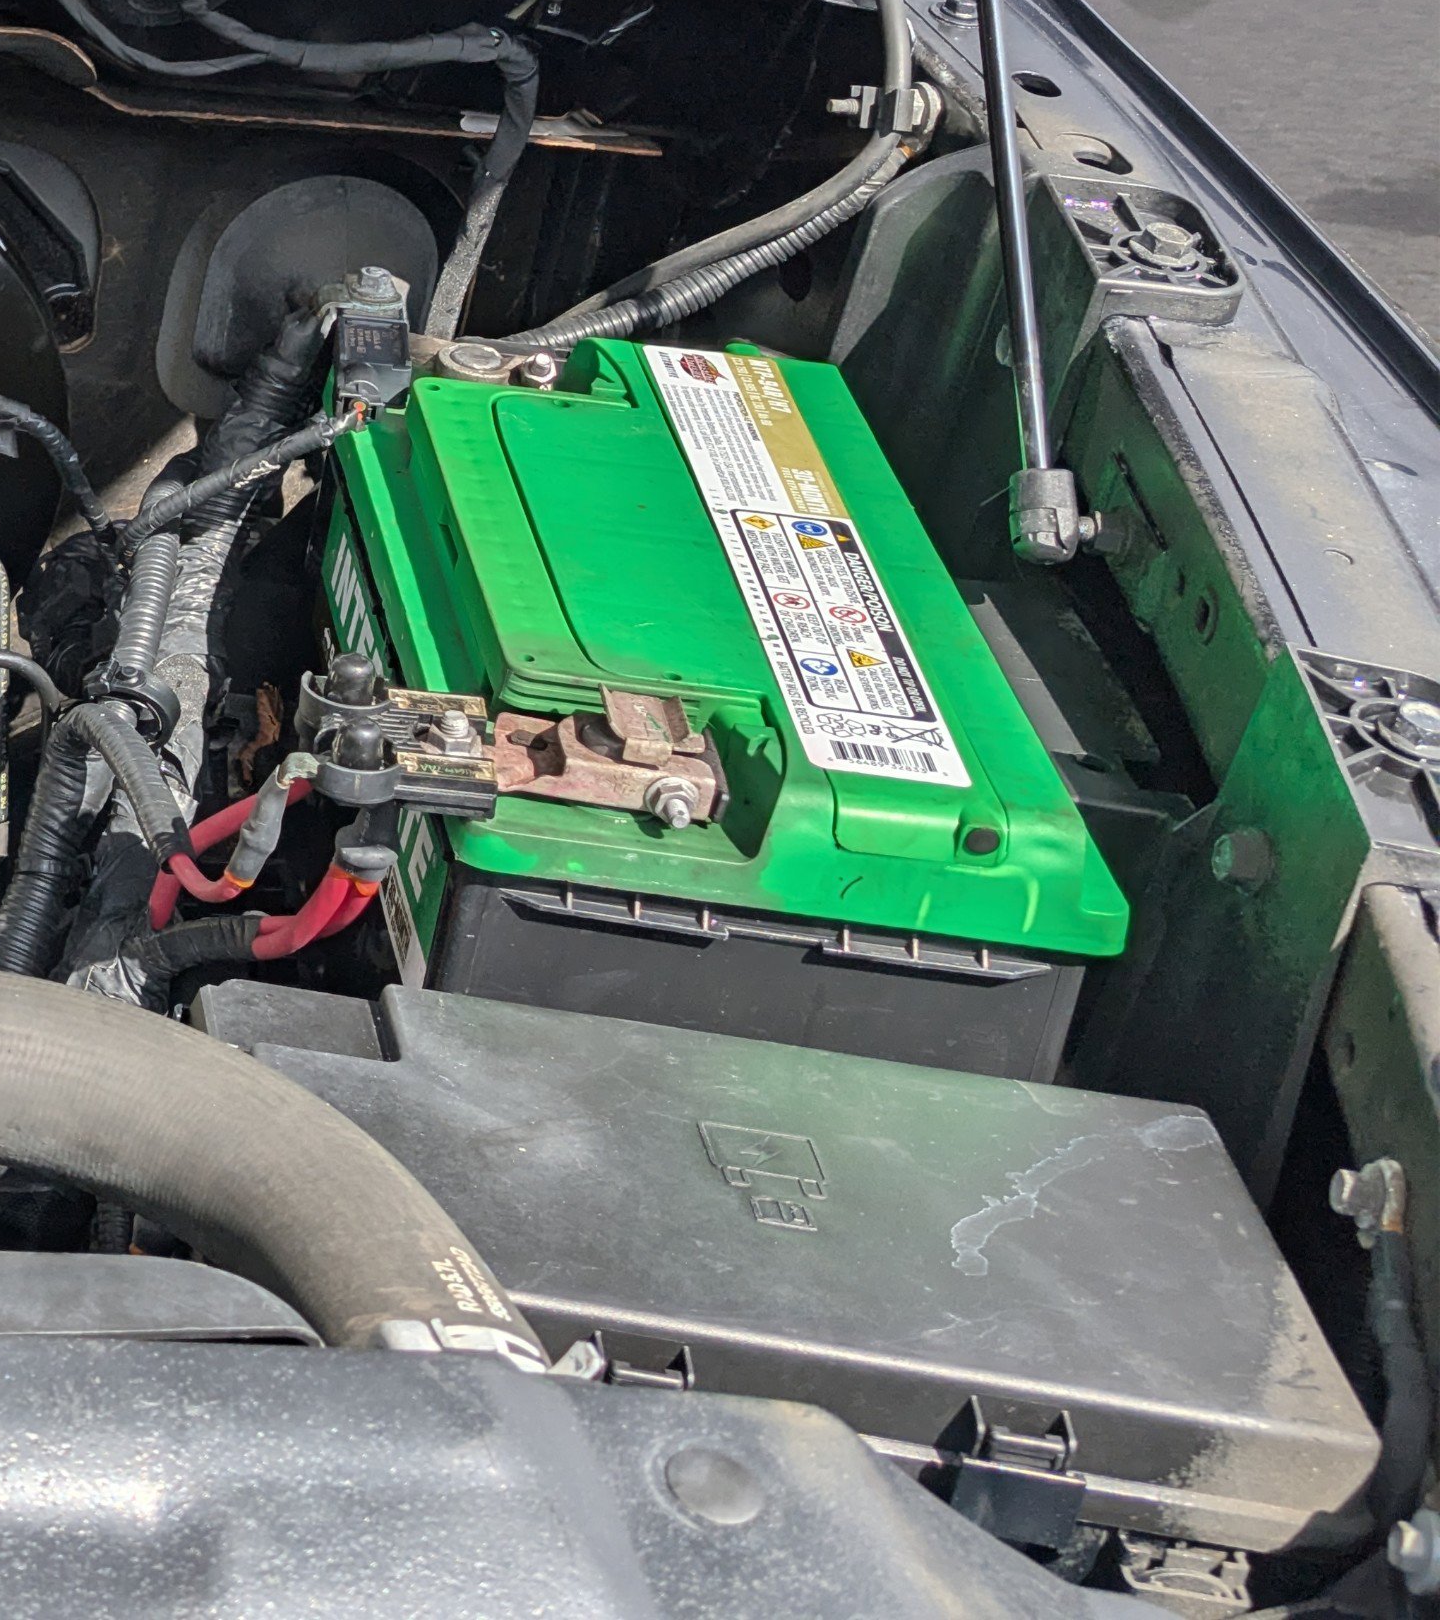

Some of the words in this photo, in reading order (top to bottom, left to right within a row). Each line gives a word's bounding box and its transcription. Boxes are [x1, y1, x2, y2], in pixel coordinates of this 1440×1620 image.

[746, 358, 792, 414] MTP-94R/H7
[789, 467, 831, 515] 30-MONTH
[843, 551, 894, 633] DANGER/POISON
[777, 609, 790, 617] OF
[791, 610, 805, 621] THE
[804, 612, 820, 627] KEEP
[795, 621, 812, 638] REACH
[810, 626, 825, 638] OUT
[860, 624, 874, 633] NO
[814, 637, 828, 645] OF
[774, 660, 795, 683] BATTERY
[783, 682, 801, 699] MUST
[832, 678, 848, 693] READ
[789, 698, 805, 707] BE
[792, 706, 816, 735] RECYCLED
[865, 723, 883, 736] Pb
